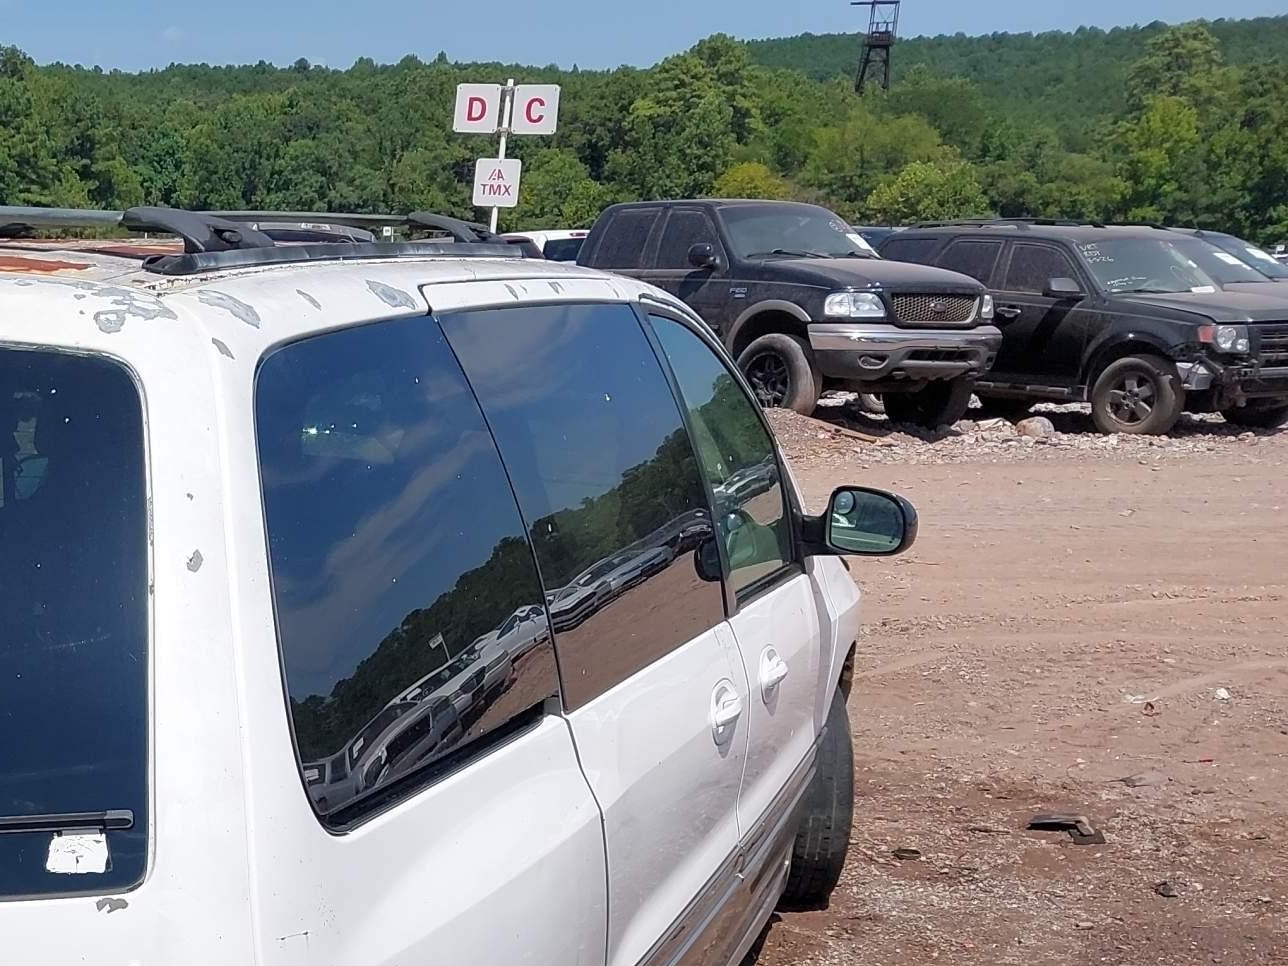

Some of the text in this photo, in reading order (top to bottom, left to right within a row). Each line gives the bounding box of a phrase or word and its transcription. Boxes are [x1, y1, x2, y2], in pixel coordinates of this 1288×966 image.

[467, 97, 487, 122] D
[525, 98, 546, 123] C
[480, 183, 512, 196] TMX
